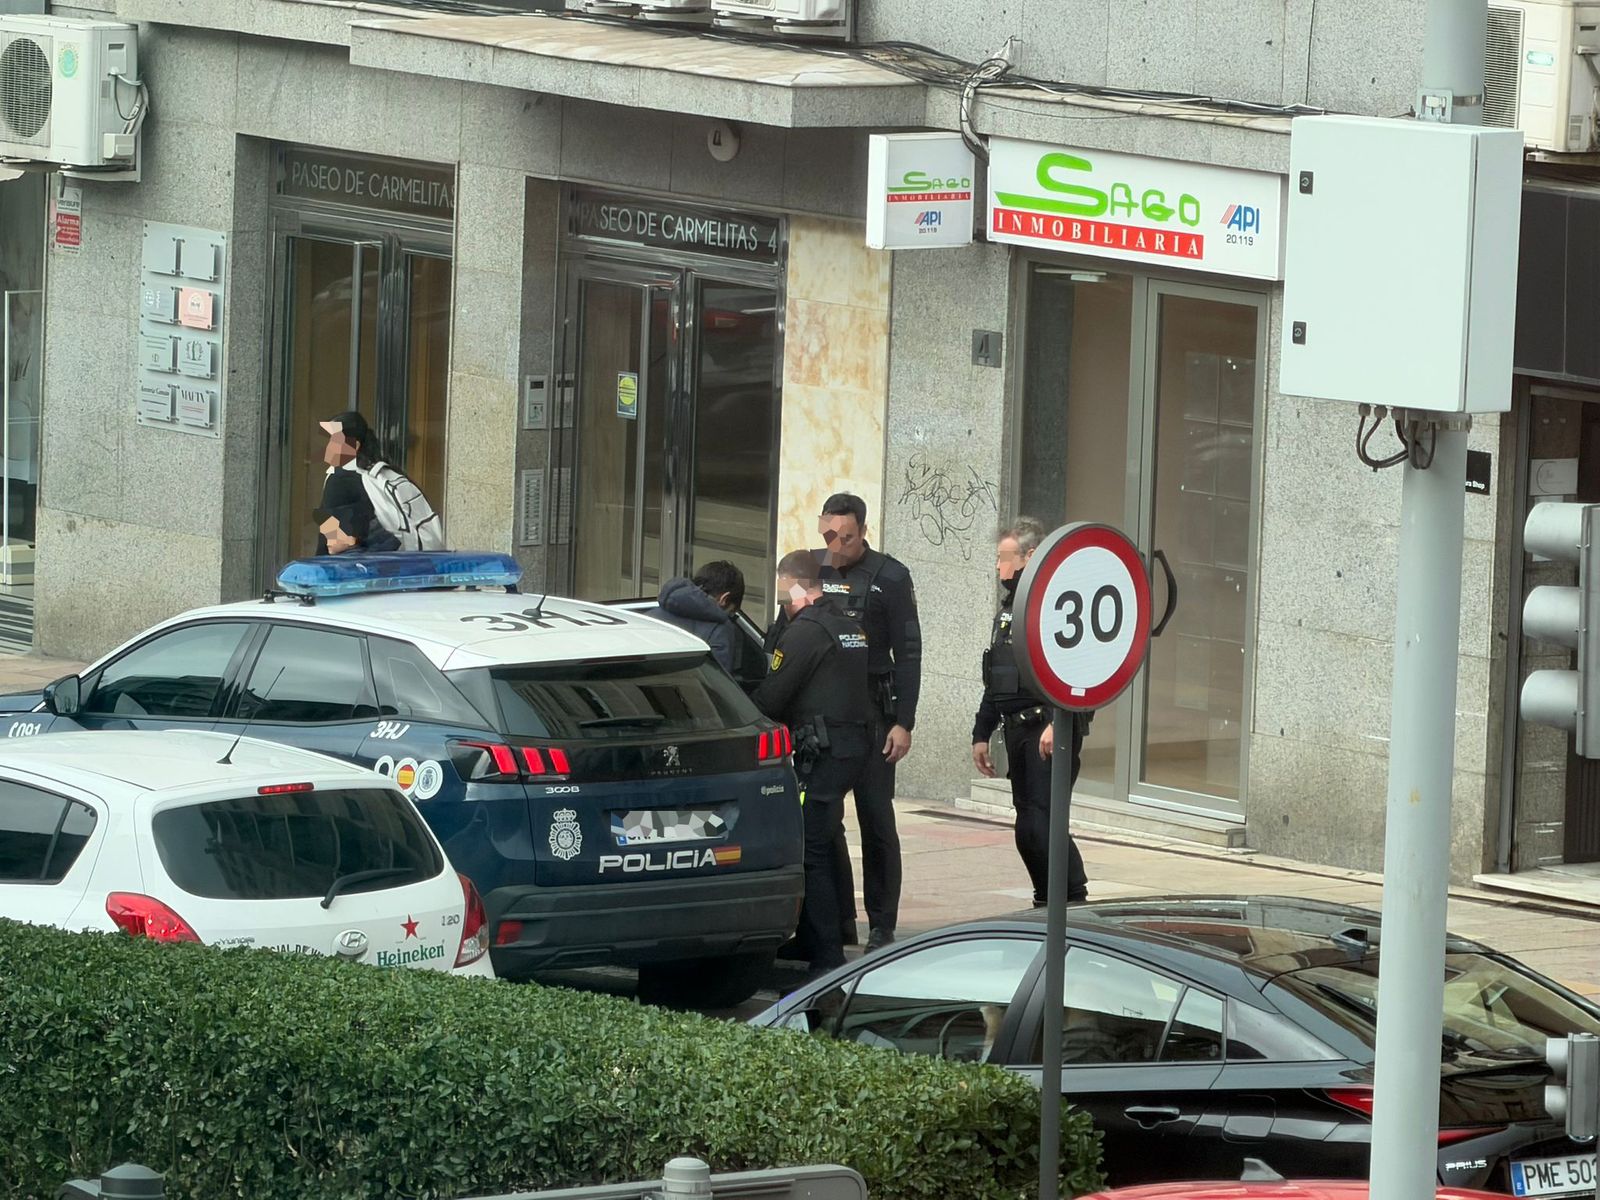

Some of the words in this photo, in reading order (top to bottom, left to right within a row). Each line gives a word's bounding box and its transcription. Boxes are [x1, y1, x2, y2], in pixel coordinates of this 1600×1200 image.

[292, 161, 341, 191] PASEO
[345, 168, 365, 195] DE
[887, 192, 970, 202] INMOBILIARIA
[636, 210, 658, 237] DE
[661, 214, 758, 252] CARMELITAS
[767, 227, 779, 254] 4
[918, 210, 942, 226] API
[1227, 204, 1261, 234] API
[998, 212, 1200, 256] INMOBILIARIA
[1226, 233, 1254, 246] 20.119
[1053, 584, 1124, 649] 30
[376, 944, 445, 967] Heineken
[1445, 1159, 1488, 1172] PRIUS
[1524, 1161, 1564, 1191] PME
